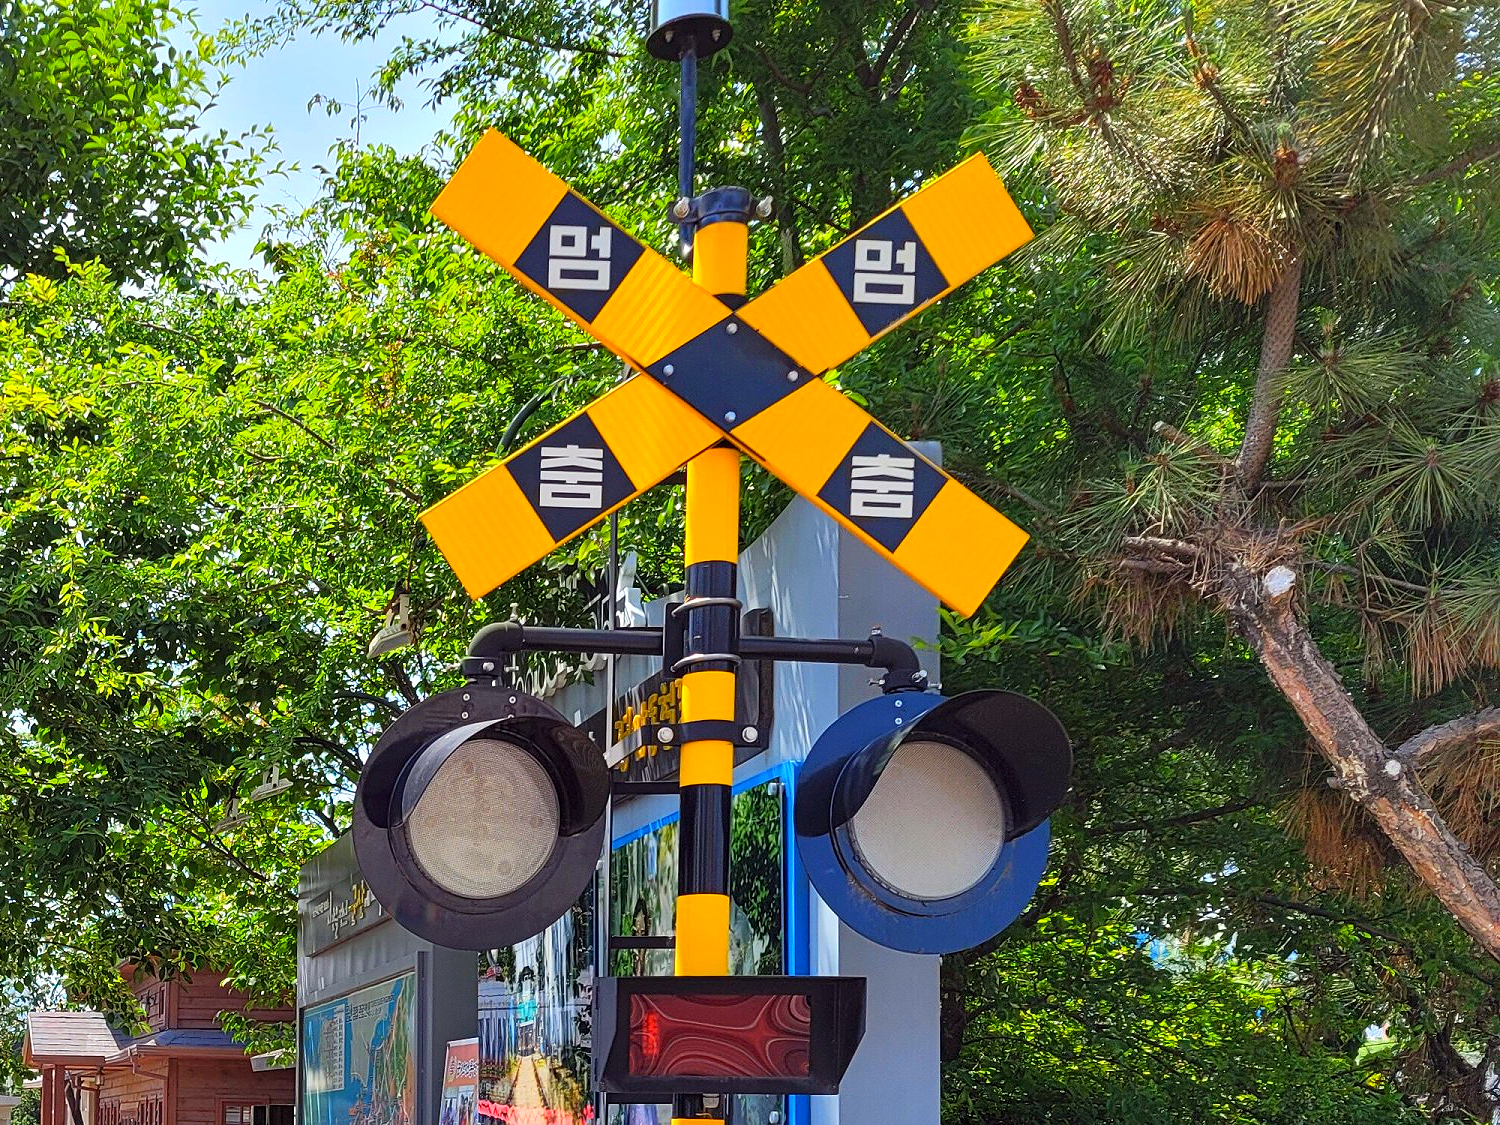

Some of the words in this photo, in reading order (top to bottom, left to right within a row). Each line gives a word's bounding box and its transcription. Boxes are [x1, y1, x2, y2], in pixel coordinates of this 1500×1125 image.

[549, 225, 612, 290] 멈
[854, 239, 916, 304] 멈
[540, 444, 603, 509] 춤
[850, 454, 915, 518] 춤
